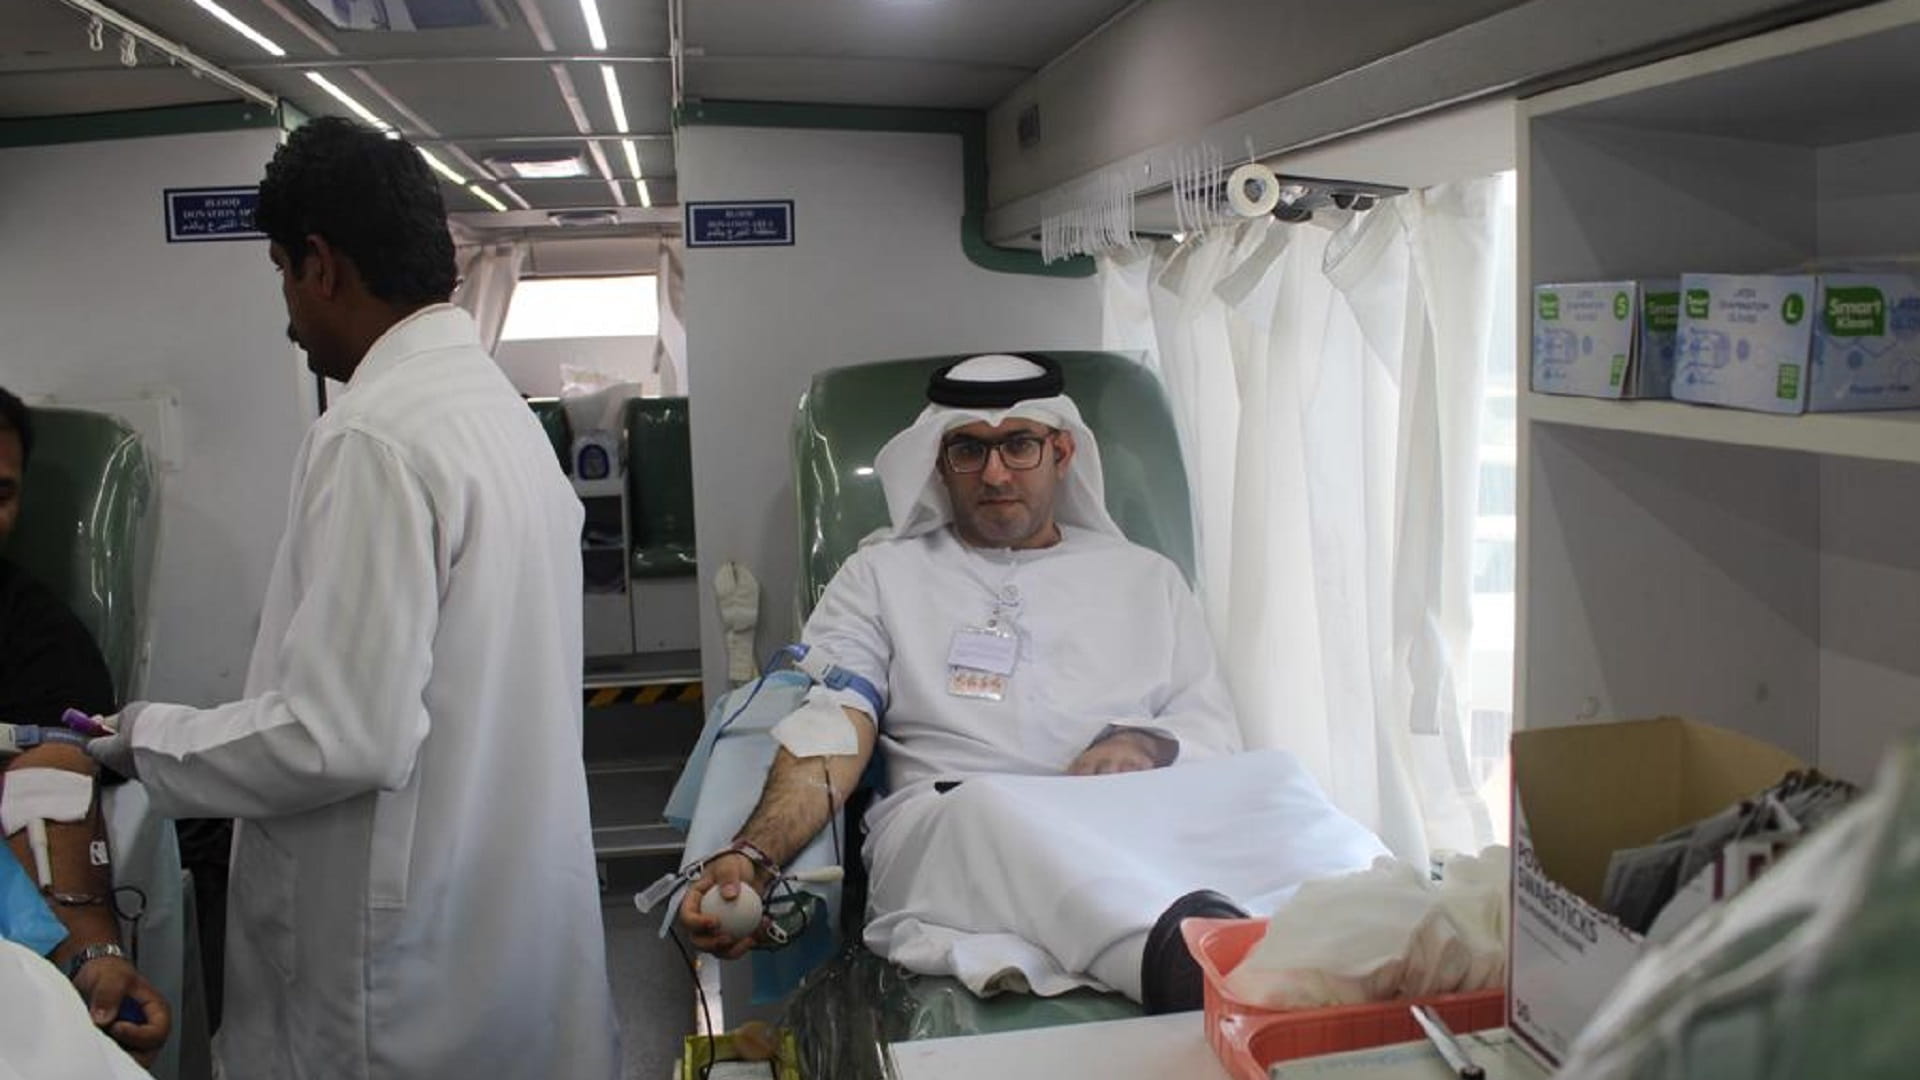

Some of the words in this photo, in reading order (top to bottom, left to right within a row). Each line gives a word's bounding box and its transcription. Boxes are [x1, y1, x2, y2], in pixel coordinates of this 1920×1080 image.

[204, 198, 240, 208] BLOOD
[183, 209, 236, 219] DONATION
[1617, 297, 1627, 316] S
[1786, 301, 1796, 319] L
[1828, 298, 1882, 315] Smart
[1518, 865, 1599, 943] SWABSTICKS
